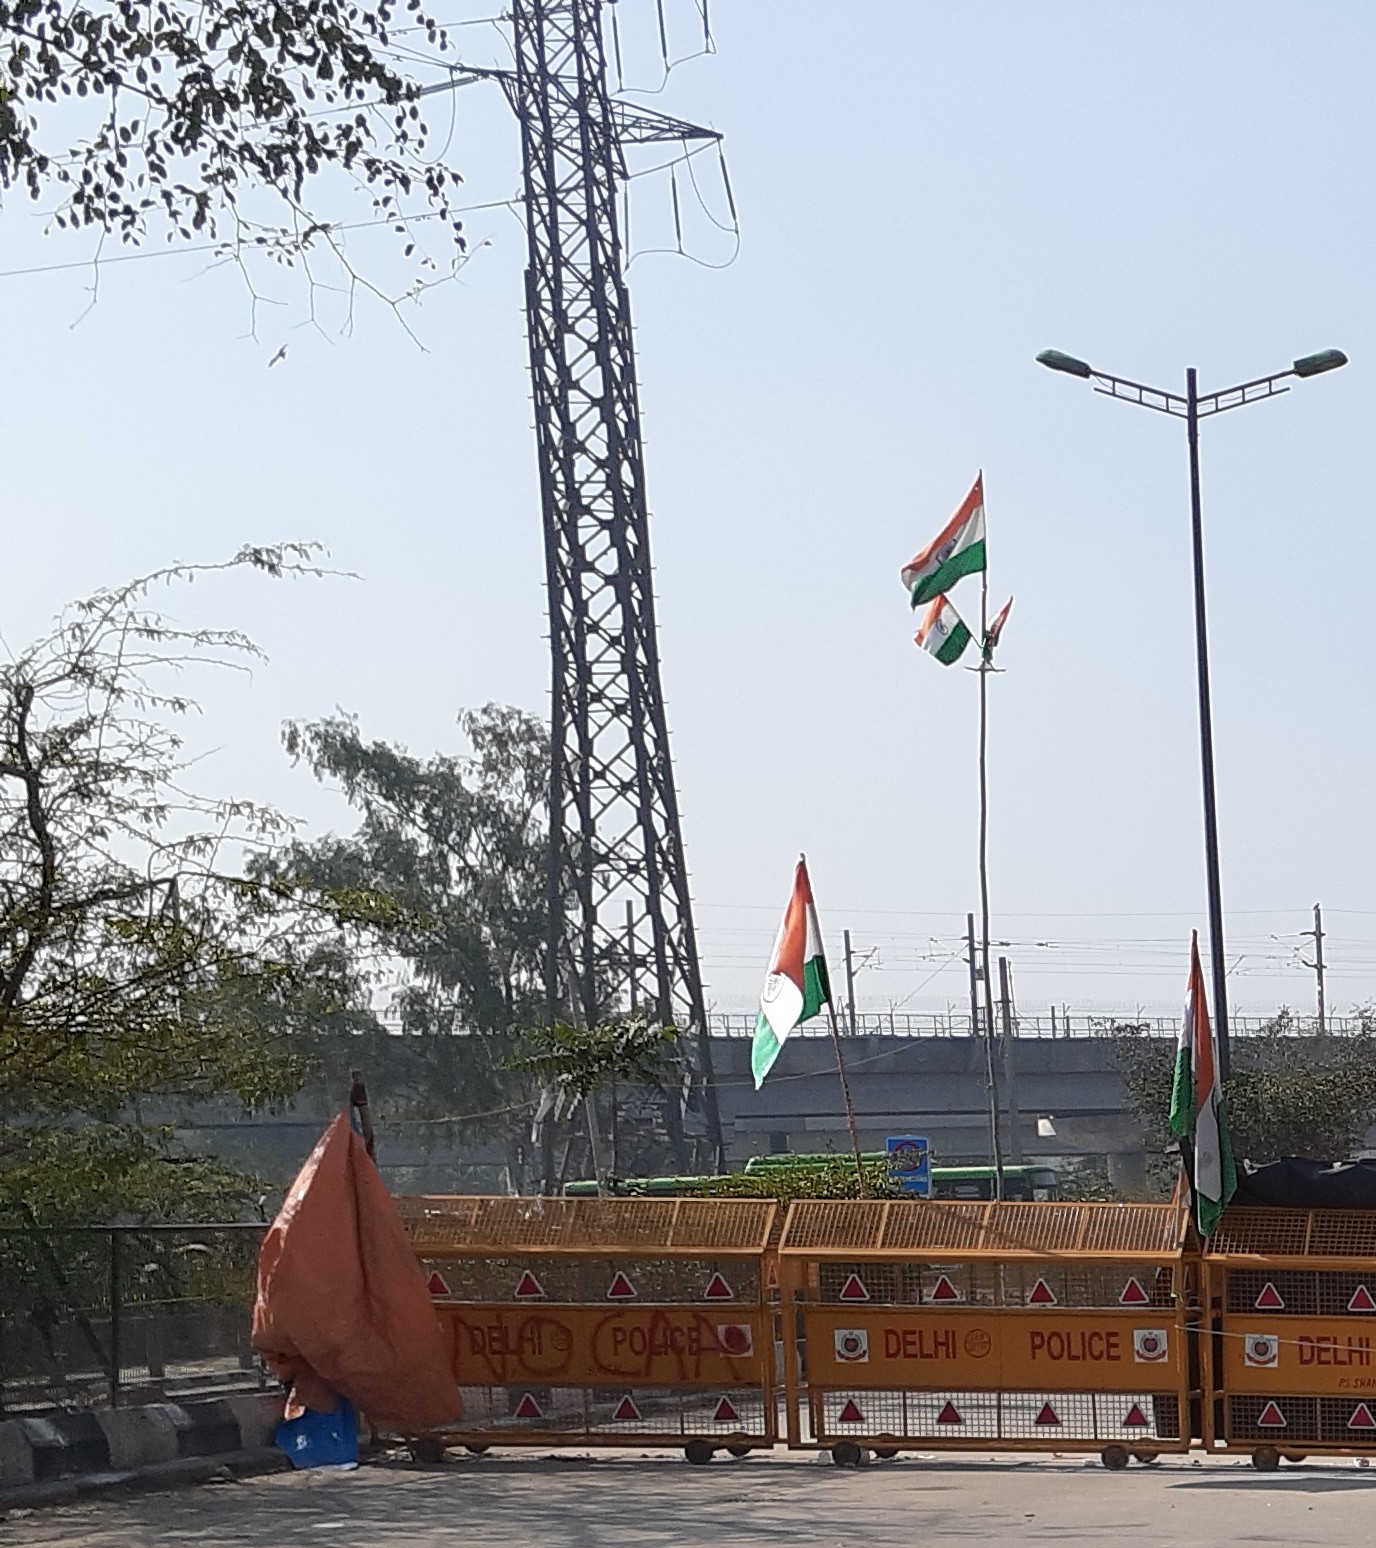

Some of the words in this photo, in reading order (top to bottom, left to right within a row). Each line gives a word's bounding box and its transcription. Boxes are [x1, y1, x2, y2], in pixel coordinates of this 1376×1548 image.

[884, 1329, 957, 1360] DELHI
[1030, 1331, 1121, 1361] POLICE
[1298, 1336, 1371, 1366] DELHI
